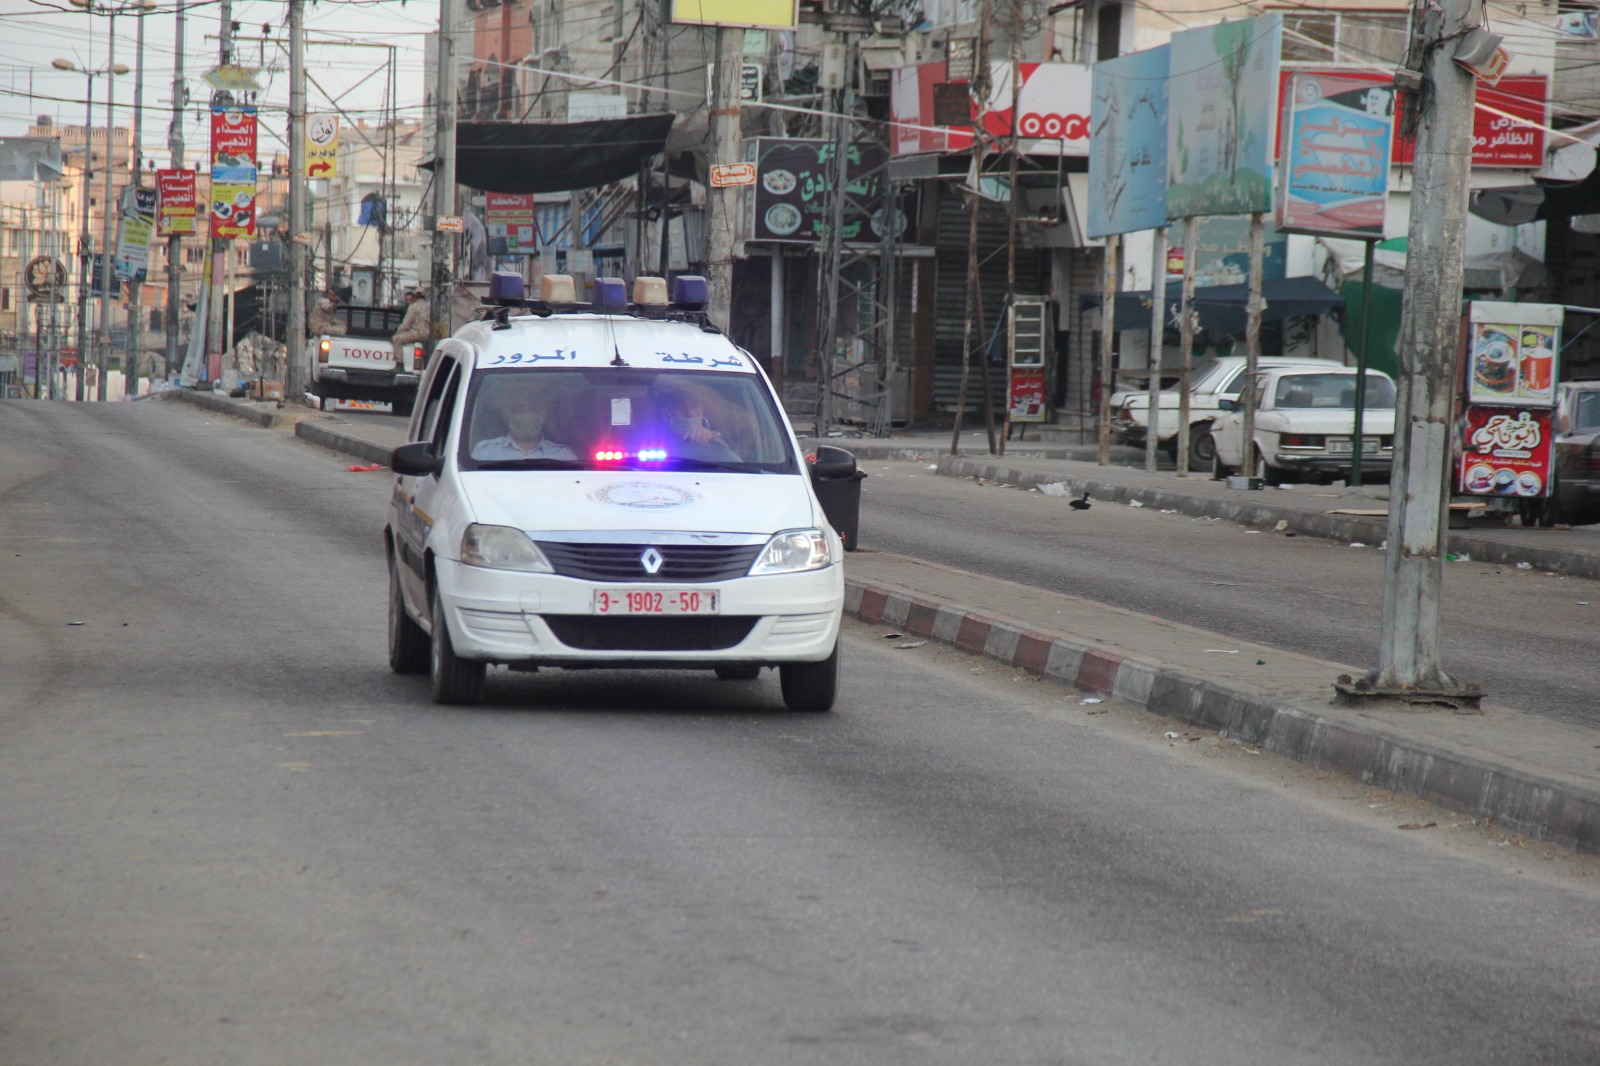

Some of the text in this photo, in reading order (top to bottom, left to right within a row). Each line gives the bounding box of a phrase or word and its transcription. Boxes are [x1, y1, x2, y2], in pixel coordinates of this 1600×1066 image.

[215, 123, 252, 134] الحذاء
[1298, 114, 1384, 136] مركز
[217, 136, 251, 151] الذهبي
[1489, 132, 1534, 148] الظافر
[161, 171, 193, 182] مركز
[714, 167, 751, 181] السميع
[163, 194, 193, 207] التعليمي
[486, 348, 743, 368] شرطة المرور
